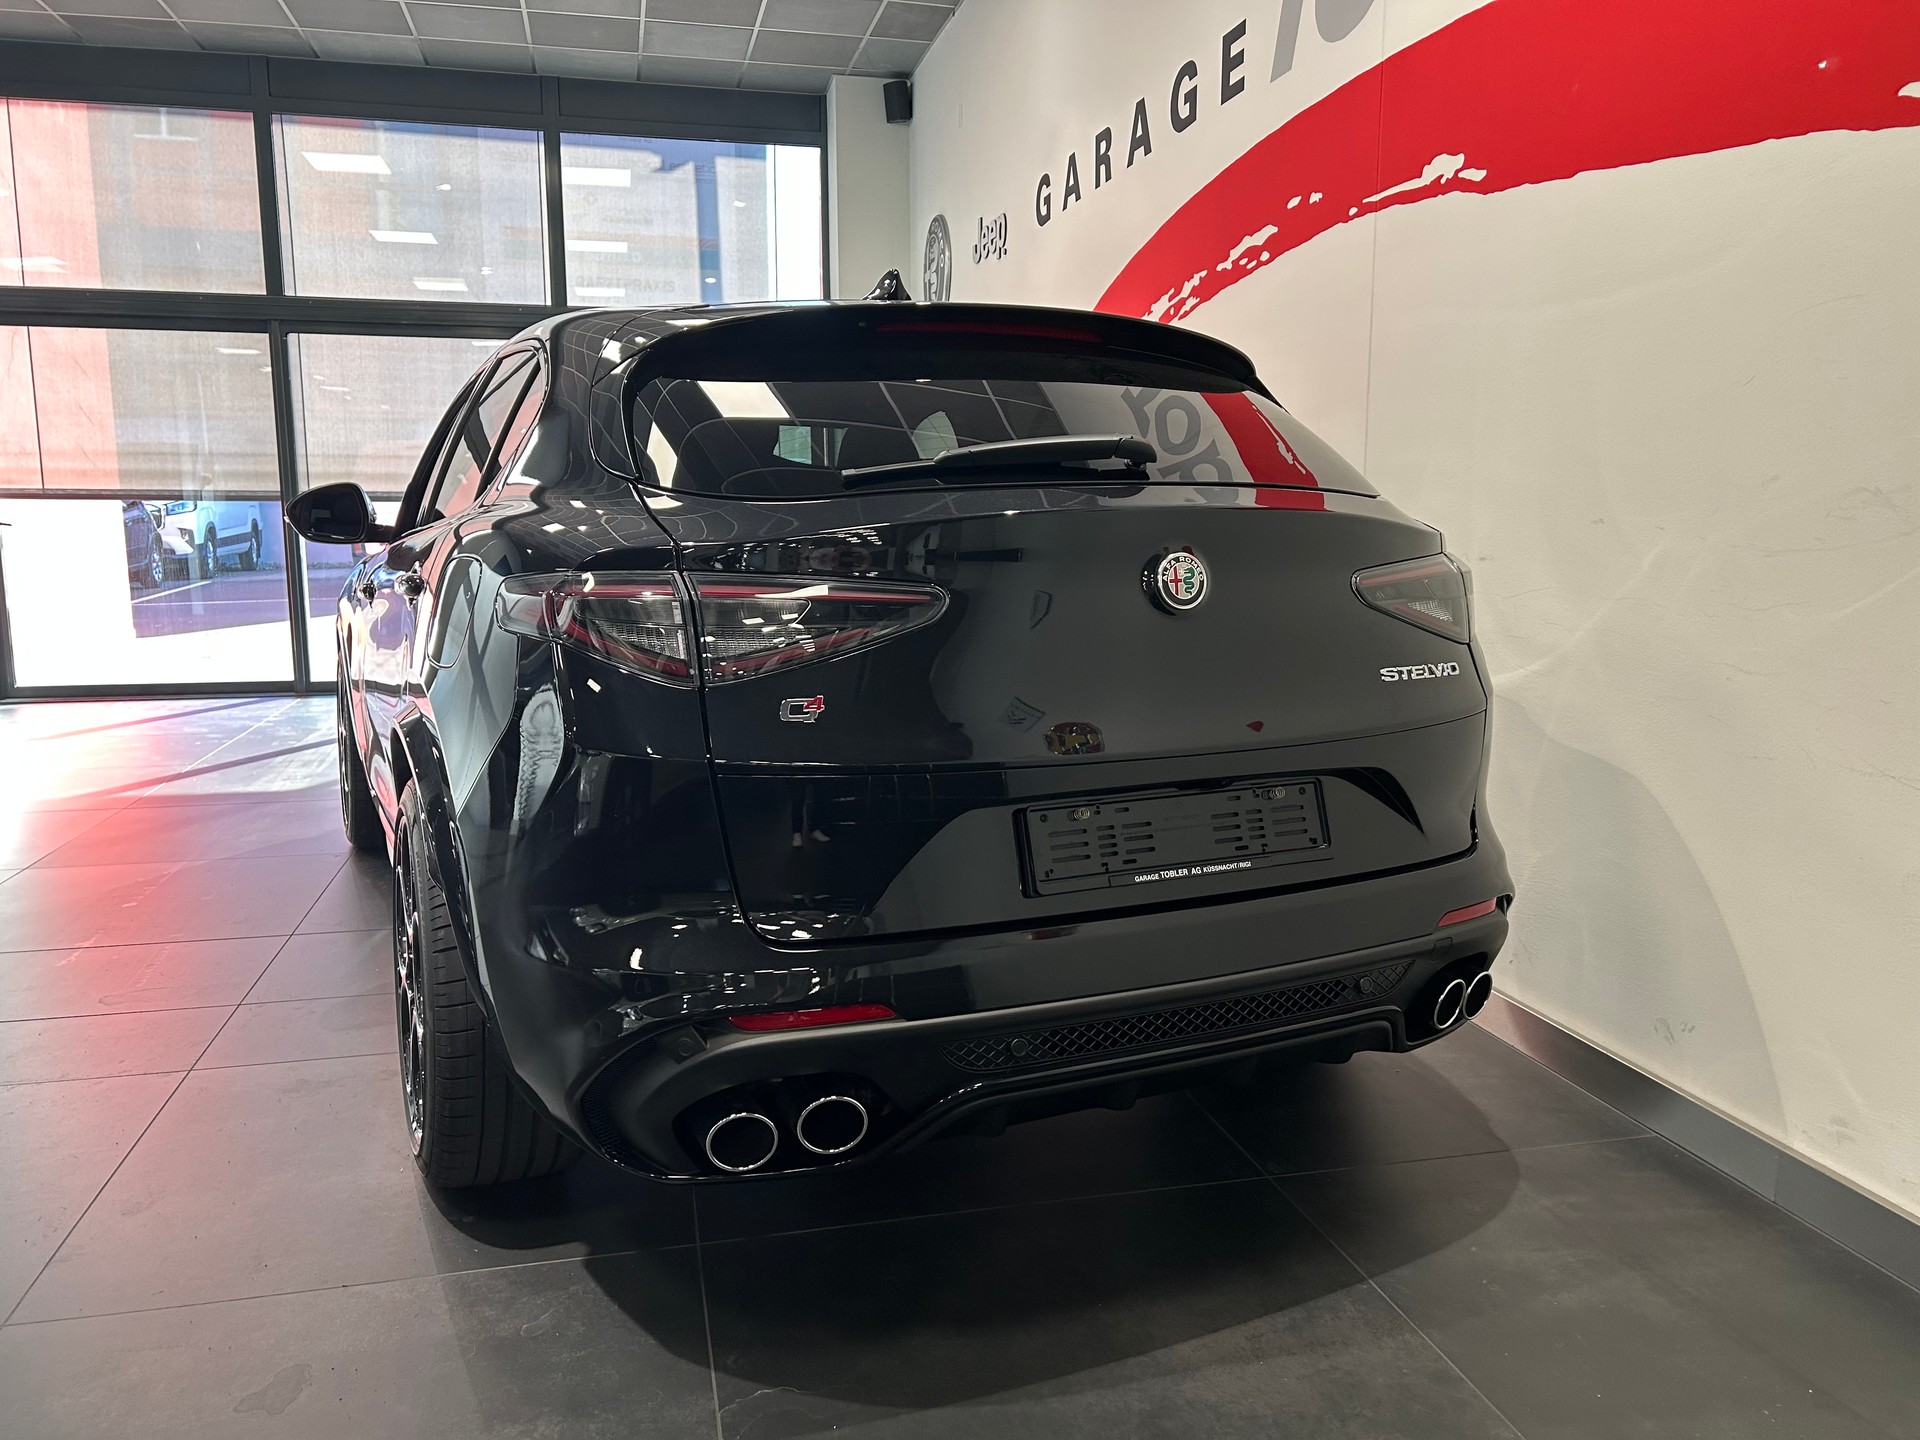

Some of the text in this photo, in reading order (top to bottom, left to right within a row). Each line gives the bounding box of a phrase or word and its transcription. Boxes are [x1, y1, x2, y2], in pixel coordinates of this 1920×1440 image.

[1035, 18, 1247, 227] GARAGE
[972, 212, 1008, 265] Jeep
[1162, 556, 1204, 582] ALFA ROMEO
[1379, 661, 1460, 681] STELVIO
[1134, 873, 1160, 882] GARAGE
[1160, 868, 1189, 878] TOBLER
[1191, 866, 1202, 875] AG
